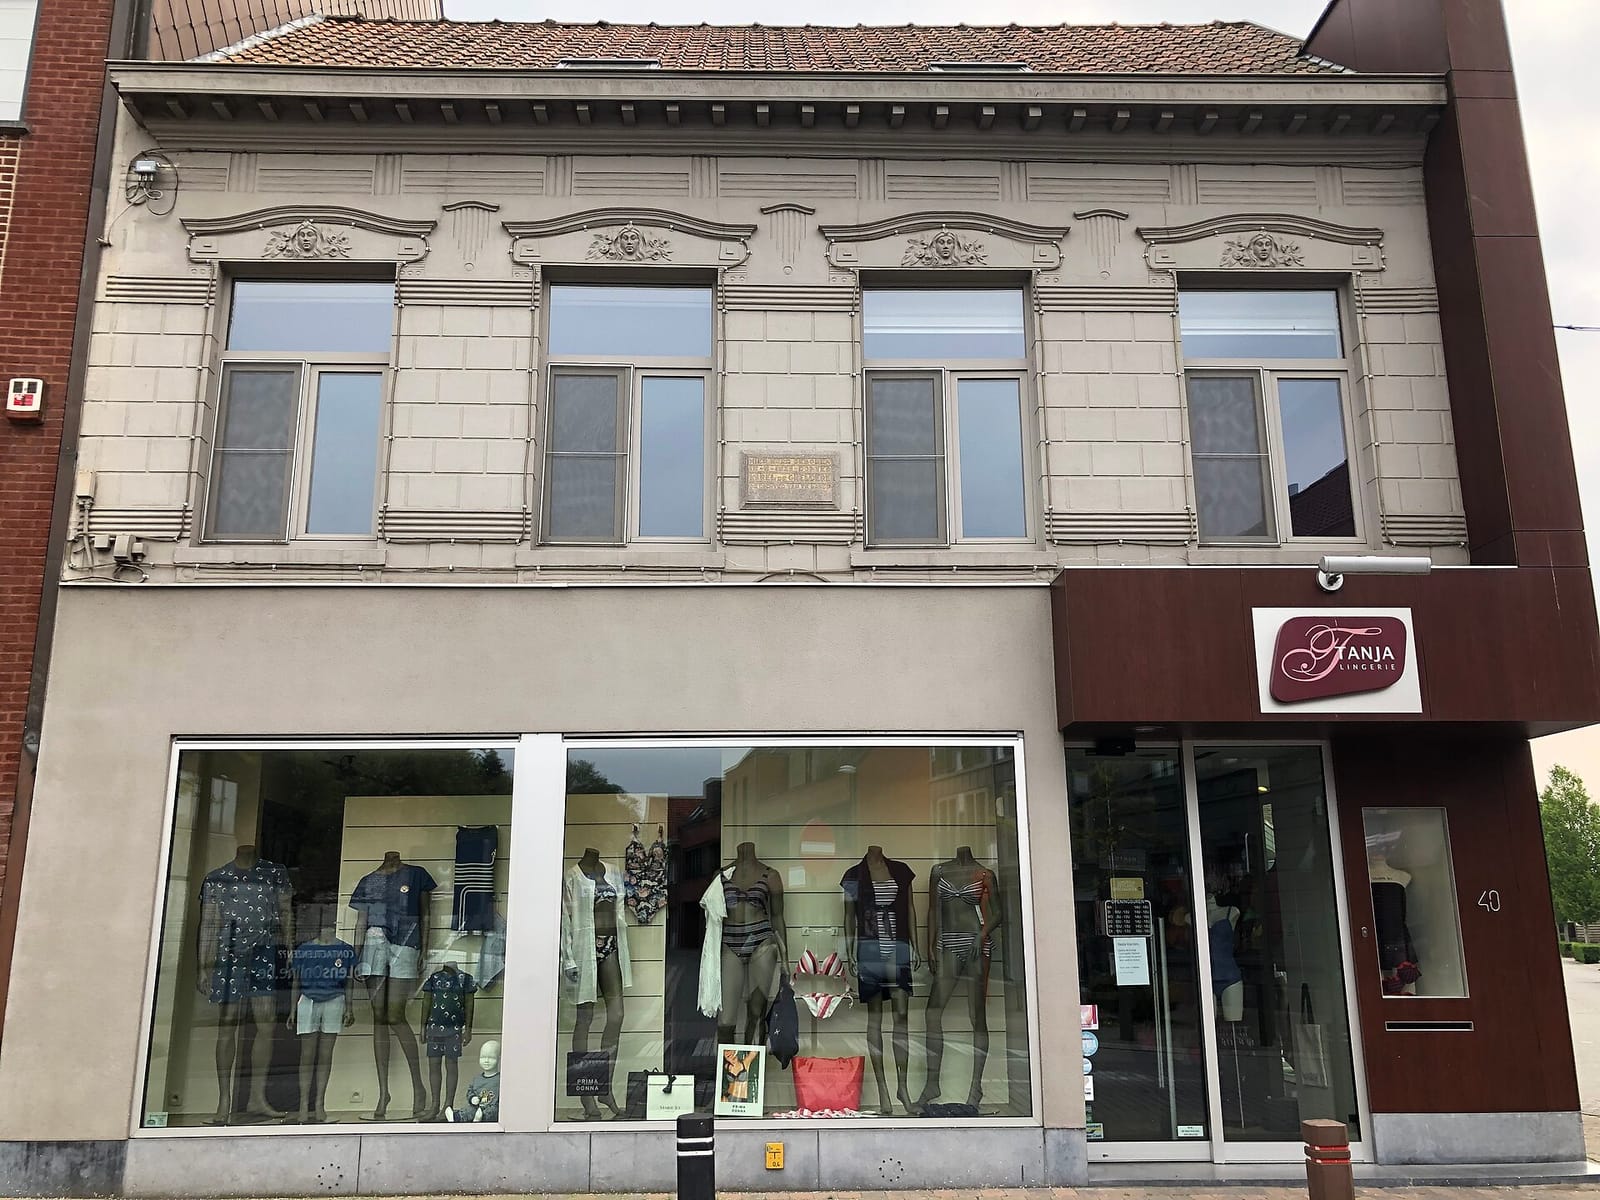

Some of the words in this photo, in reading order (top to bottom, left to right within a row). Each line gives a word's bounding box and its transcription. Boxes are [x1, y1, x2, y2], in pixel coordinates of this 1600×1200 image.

[1335, 646, 1395, 662] TANJA
[1339, 663, 1396, 671] LINGERIE
[1477, 889, 1501, 912] 40
